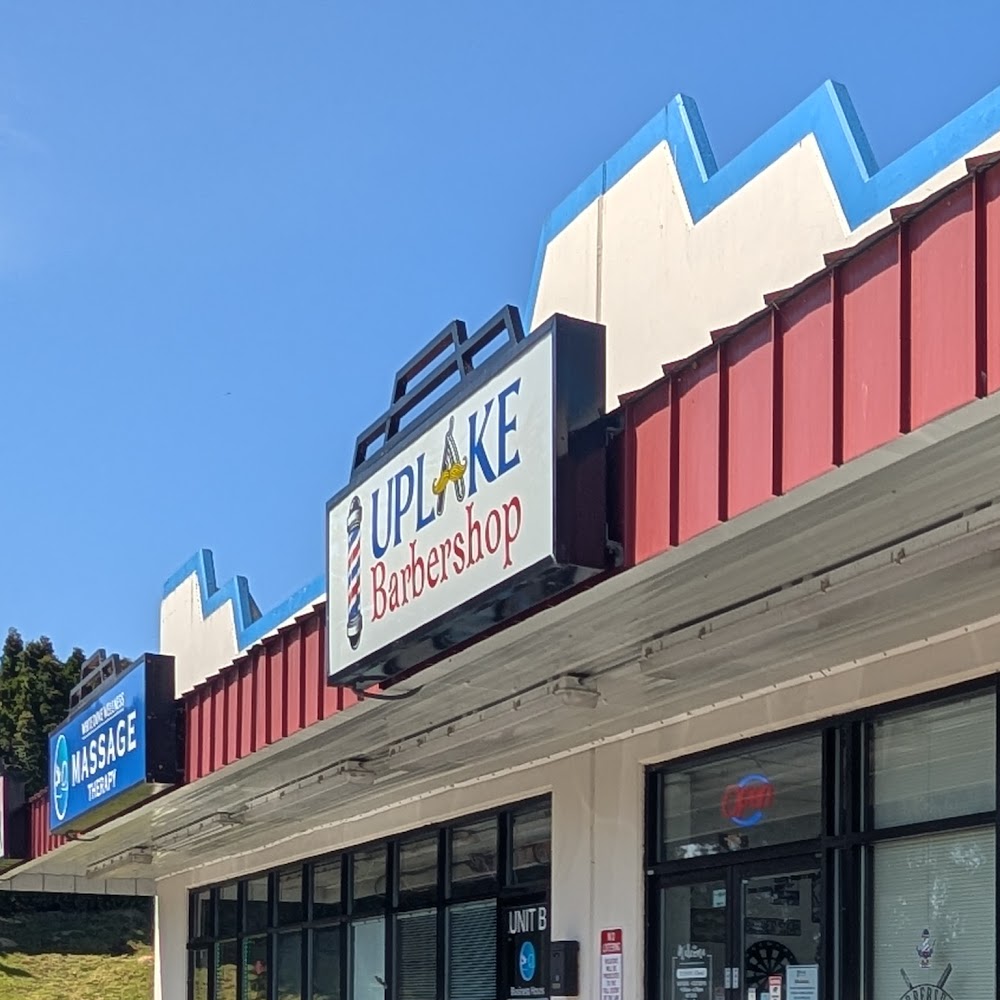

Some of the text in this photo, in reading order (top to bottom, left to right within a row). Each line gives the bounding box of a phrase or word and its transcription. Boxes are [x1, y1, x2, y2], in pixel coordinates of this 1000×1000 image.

[371, 377, 521, 559] UPLAKE
[370, 496, 522, 622] Barbershop
[72, 710, 137, 787] MASSAGE
[87, 768, 117, 802] THERAPY
[508, 907, 547, 935] UNIT B
